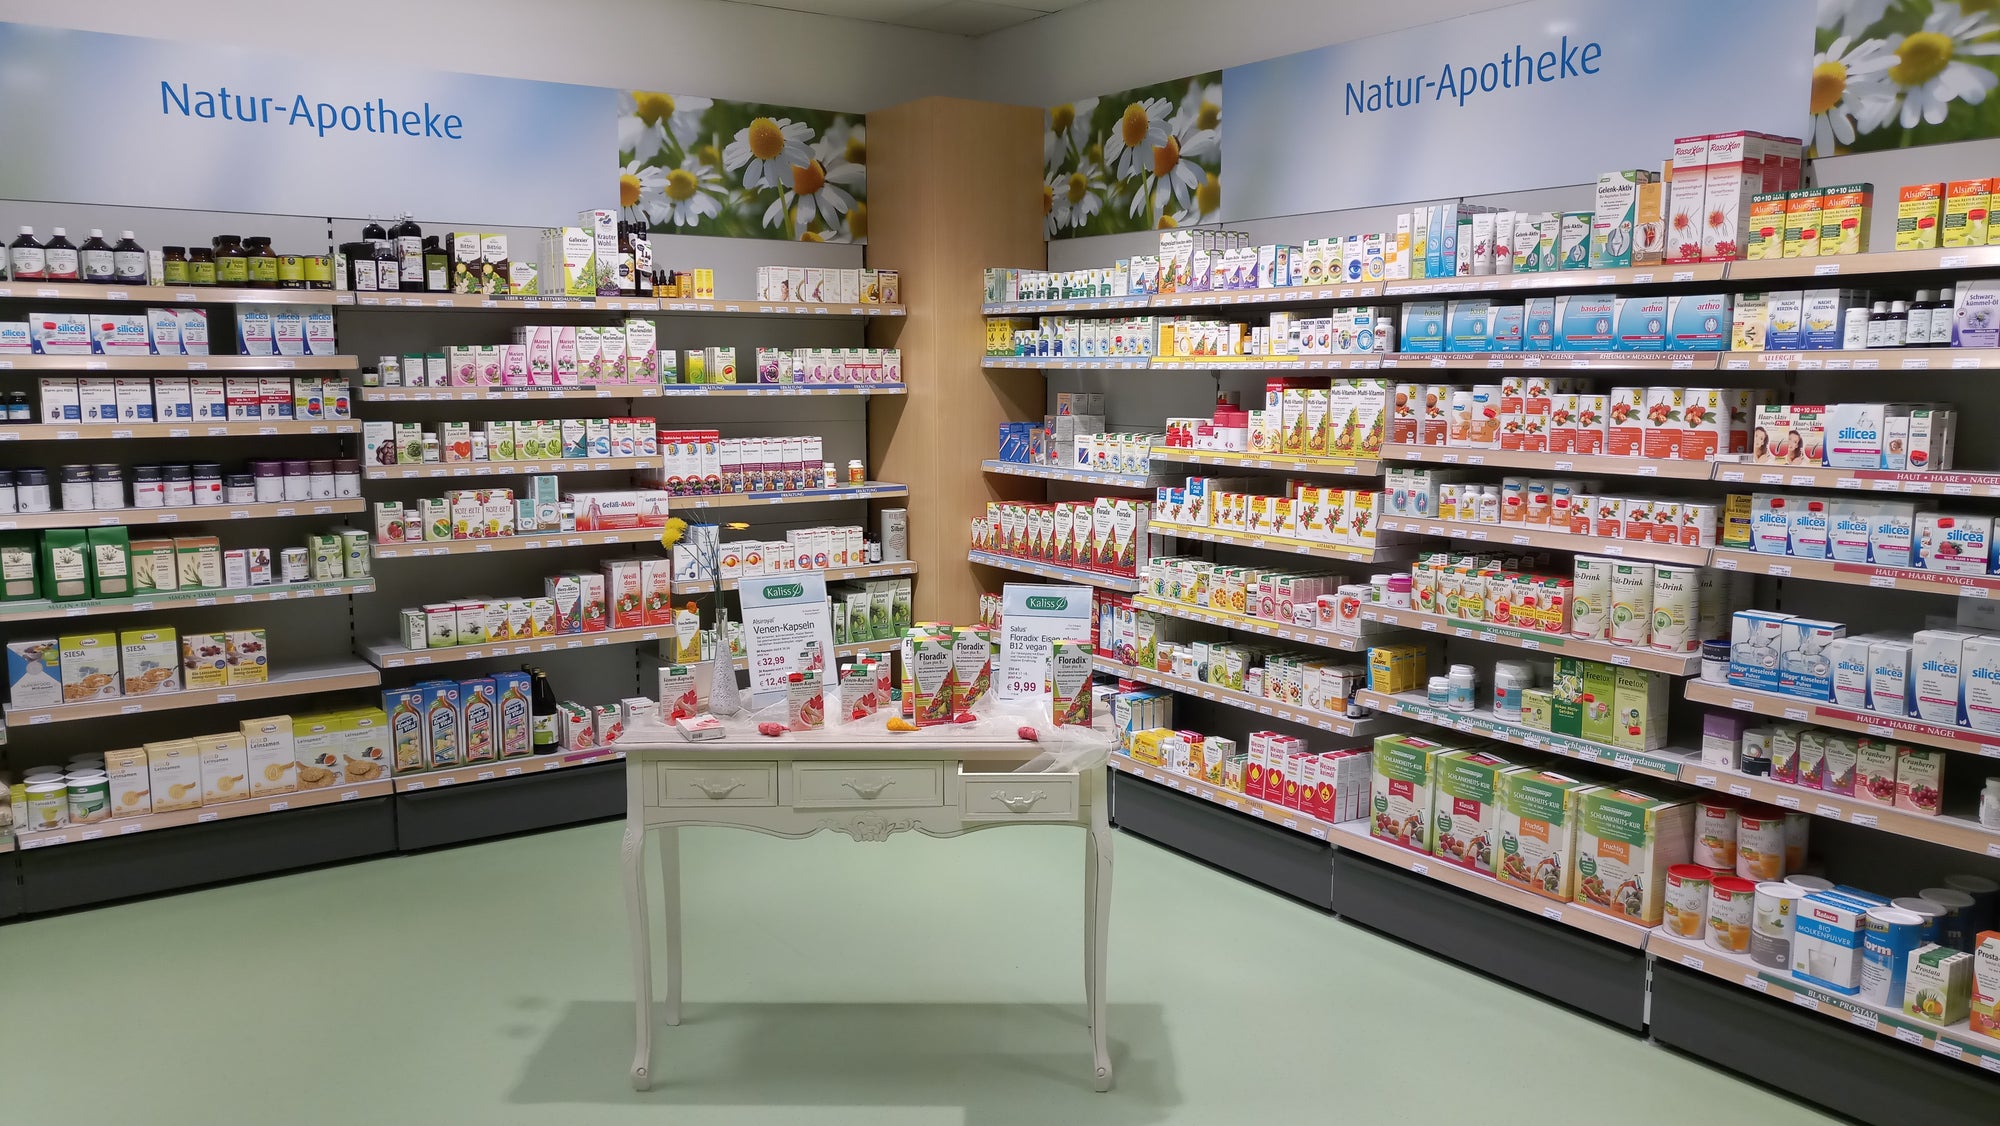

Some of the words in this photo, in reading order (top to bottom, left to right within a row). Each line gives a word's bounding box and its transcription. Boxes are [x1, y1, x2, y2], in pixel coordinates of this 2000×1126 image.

[1345, 36, 1602, 116] Natur-Apotheke
[160, 80, 463, 140] Natur-Apotheke
[1598, 184, 1633, 197] Gelenk-Aktiv
[1790, 191, 1809, 199] 90+10
[1827, 187, 1847, 198] 90+10
[1753, 195, 1771, 203] 90+10
[597, 232, 617, 242] Kräuter
[1969, 292, 1995, 302] Schwarz-
[1641, 304, 1663, 313] arthro
[1696, 302, 1720, 312] arthro
[1776, 304, 1799, 312] KERZEN-ÖL
[1966, 298, 1999, 308] kümmel-Öl
[1423, 309, 1440, 317] basis
[1469, 307, 1486, 316] basis
[1596, 304, 1612, 315] plus
[244, 312, 269, 321] silicea
[276, 312, 301, 321] silicea
[308, 312, 332, 321] silicea
[57, 323, 86, 333] silicea
[116, 324, 145, 334] silicea
[156, 320, 177, 328] silicea
[184, 321, 205, 329] silicea
[1, 329, 26, 337] silicea
[1761, 353, 1796, 362] ALLERGIE
[1838, 426, 1877, 440] silicea
[1896, 473, 1921, 481] HAUT
[1930, 474, 1961, 482] HAARE
[1969, 475, 2000, 484] NÄGEL
[454, 506, 467, 515] ROTE
[467, 505, 481, 514] BETE
[485, 505, 497, 513] ROTE
[498, 504, 511, 513] BETE
[601, 500, 636, 510] Gefäß-Aktiv
[1758, 513, 1786, 524] silicea
[1796, 516, 1825, 528] silicea
[1837, 520, 1867, 532] silicea
[1878, 523, 1909, 535] silicea
[1946, 529, 1984, 543] silicea
[622, 573, 637, 581] Weiß
[652, 572, 667, 580] Weiß
[1875, 569, 1899, 577] HAUT
[1908, 571, 1937, 581] HAARE
[1946, 575, 1975, 587] NÄGEL
[623, 579, 637, 587] dorn
[653, 578, 666, 586] dorn
[198, 591, 217, 599] DARM
[767, 586, 791, 598] Kaliss
[1030, 598, 1055, 609] Kaliss
[753, 620, 815, 635] Venen-Kapseln
[1010, 625, 1026, 633] Salus
[1486, 627, 1521, 638] SCHLANKHEIT
[1009, 633, 1039, 643] Floradix
[126, 645, 146, 653] SIESA
[957, 642, 986, 651] Floradix
[1009, 642, 1023, 651] B12
[1025, 643, 1048, 653] vegan
[64, 650, 85, 658] SIESA
[919, 652, 948, 661] Floradix
[762, 656, 785, 667] 32,99
[1058, 656, 1087, 665] Floradix
[1748, 665, 1777, 676] Kieselerde
[1837, 660, 1865, 673] silicea
[1874, 665, 1903, 678] silicea
[1922, 659, 1958, 674] silicea
[663, 676, 694, 684] Venen-Kapseln
[1586, 671, 1612, 683] Freetox
[1745, 672, 1761, 680] Pulver
[1800, 673, 1828, 685] Kieselerde
[1013, 681, 1037, 694] 9,99
[1618, 676, 1646, 690] Freetox
[1795, 680, 1812, 688] Pulver
[1460, 716, 1495, 730] Schlankheit
[1856, 714, 1880, 724] HAUT
[1889, 718, 1919, 730] HAARE
[1927, 725, 1955, 739] NÄGEL
[1505, 727, 1551, 745] Fettverdauung
[250, 740, 280, 750] Leinsamen
[1174, 743, 1187, 754] Q10
[1564, 740, 1602, 757] Schlankheit
[1860, 748, 1892, 762] Cranberry
[203, 757, 230, 766] Leinsamen
[1383, 755, 1422, 770] SCHLANKHEITS-KUR
[1616, 752, 1667, 771] Fettverdauung
[1901, 757, 1937, 770] Cranberry
[154, 765, 182, 774] Leinsamen
[110, 772, 138, 781] Leinsamen
[1447, 772, 1491, 789] SCHLANKHEITS-KUR
[1393, 782, 1409, 792] Klassik
[1513, 791, 1560, 809] SCHLANKHEITS-KUR
[1458, 801, 1475, 812] Klassik
[1590, 811, 1641, 830] SCHLANKHEITS-KUR
[1524, 820, 1544, 834] Fruchtig
[1602, 841, 1624, 854] Fruchtig
[1818, 924, 1831, 933] BIO
[1797, 925, 1852, 947] MOLKENPULVER
[1915, 964, 1941, 978] Prostata
[1807, 989, 1831, 1004] BLASE
[1838, 1000, 1880, 1021] PROSTATA
